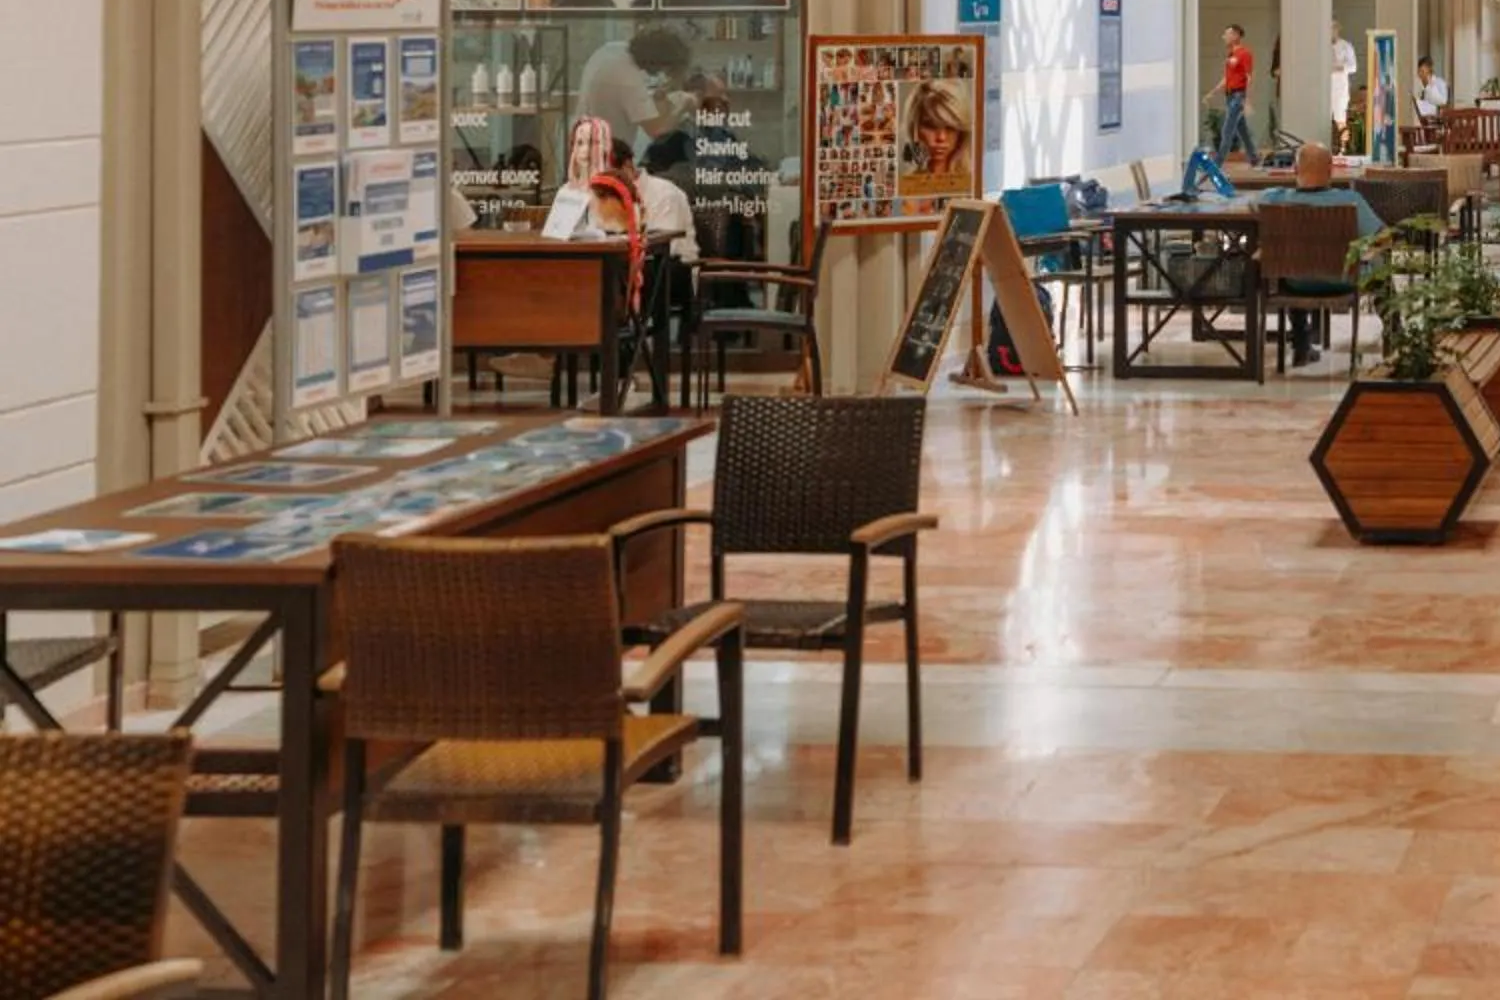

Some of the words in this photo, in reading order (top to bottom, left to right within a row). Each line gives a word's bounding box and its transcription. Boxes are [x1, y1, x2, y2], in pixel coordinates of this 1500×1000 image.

[695, 108, 725, 127] Hair
[727, 109, 752, 128] cut
[695, 137, 748, 160] Shaving
[695, 167, 724, 185] Hair
